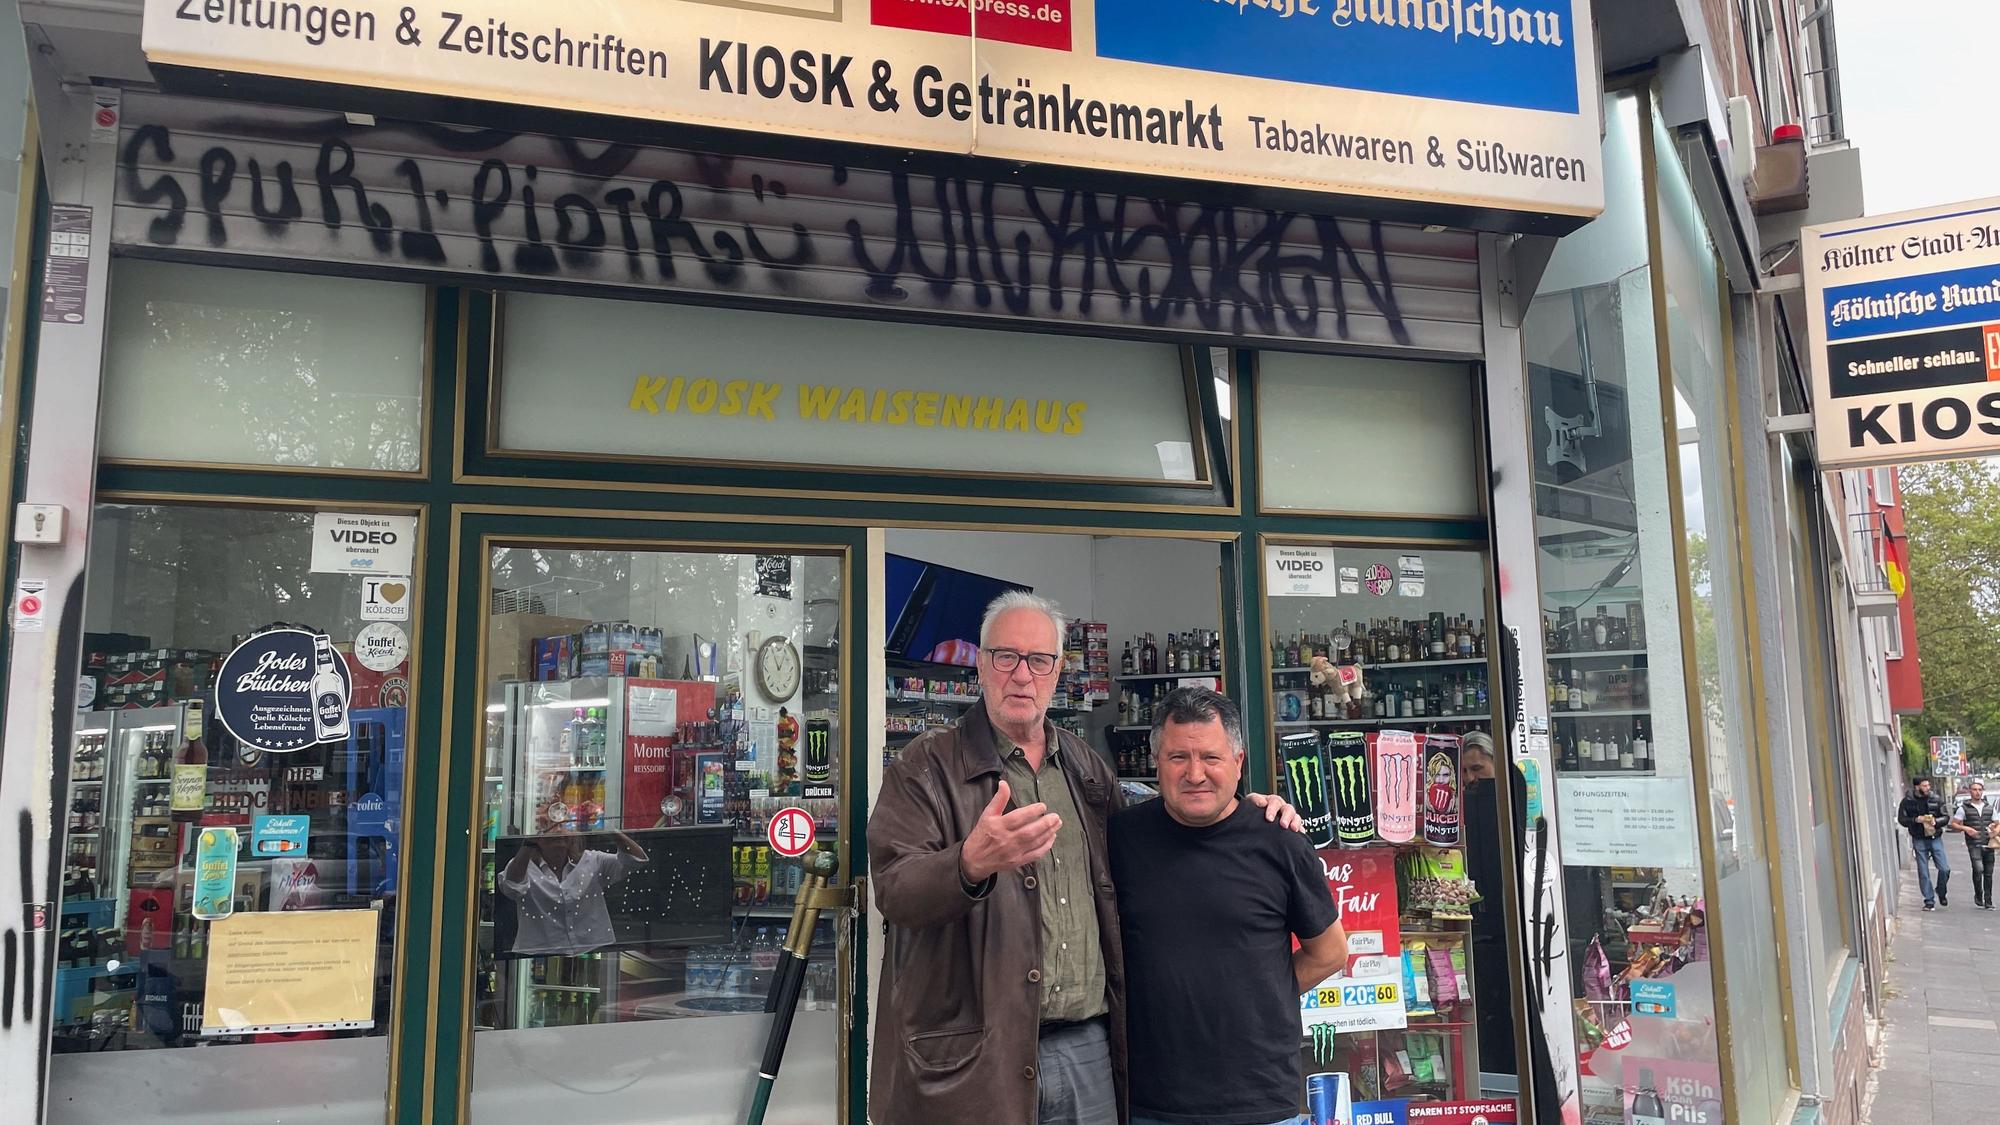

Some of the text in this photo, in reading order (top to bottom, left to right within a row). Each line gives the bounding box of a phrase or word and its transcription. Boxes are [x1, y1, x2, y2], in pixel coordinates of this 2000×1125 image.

[903, 0, 1062, 23] w.express.de
[176, 0, 669, 79] Zeitungen & Zeitschriften
[699, 37, 1224, 152] KIOSK & Getränkemarkt
[1248, 115, 1586, 183] Tabakwaren & Süßwaren
[1820, 244, 1896, 273] Kölner
[1830, 290, 1937, 327] Kölnische
[1848, 349, 1981, 378] Schneller schlau.
[628, 373, 1088, 437] KIOSK WAISENHAUS
[330, 529, 397, 545] VIDEO
[1276, 559, 1324, 572] VIDEO
[366, 583, 379, 604] I
[365, 605, 405, 615] KÖLSCH
[367, 637, 396, 648] Gaffel
[236, 671, 311, 693] Büdchen
[250, 713, 312, 723] Quelle Kölscher
[252, 704, 311, 714] Ausgezeichnete
[319, 704, 342, 716] Gaffel
[254, 722, 306, 731] Lebensfreude
[805, 786, 832, 797] DRÜCKEN
[1301, 812, 1332, 827] ONSTER
[1335, 885, 1380, 920] Fair
[1319, 990, 1336, 1004] 28
[1345, 985, 1365, 1006] 20
[1377, 986, 1393, 1001] 60
[1666, 1076, 1713, 1099] Köln
[1356, 1114, 1372, 1125] RED
[1374, 1112, 1394, 1125] BULL
[1409, 1103, 1515, 1117] SPAREN IST STOPFSACHE.
[1670, 1103, 1707, 1124] Pils
